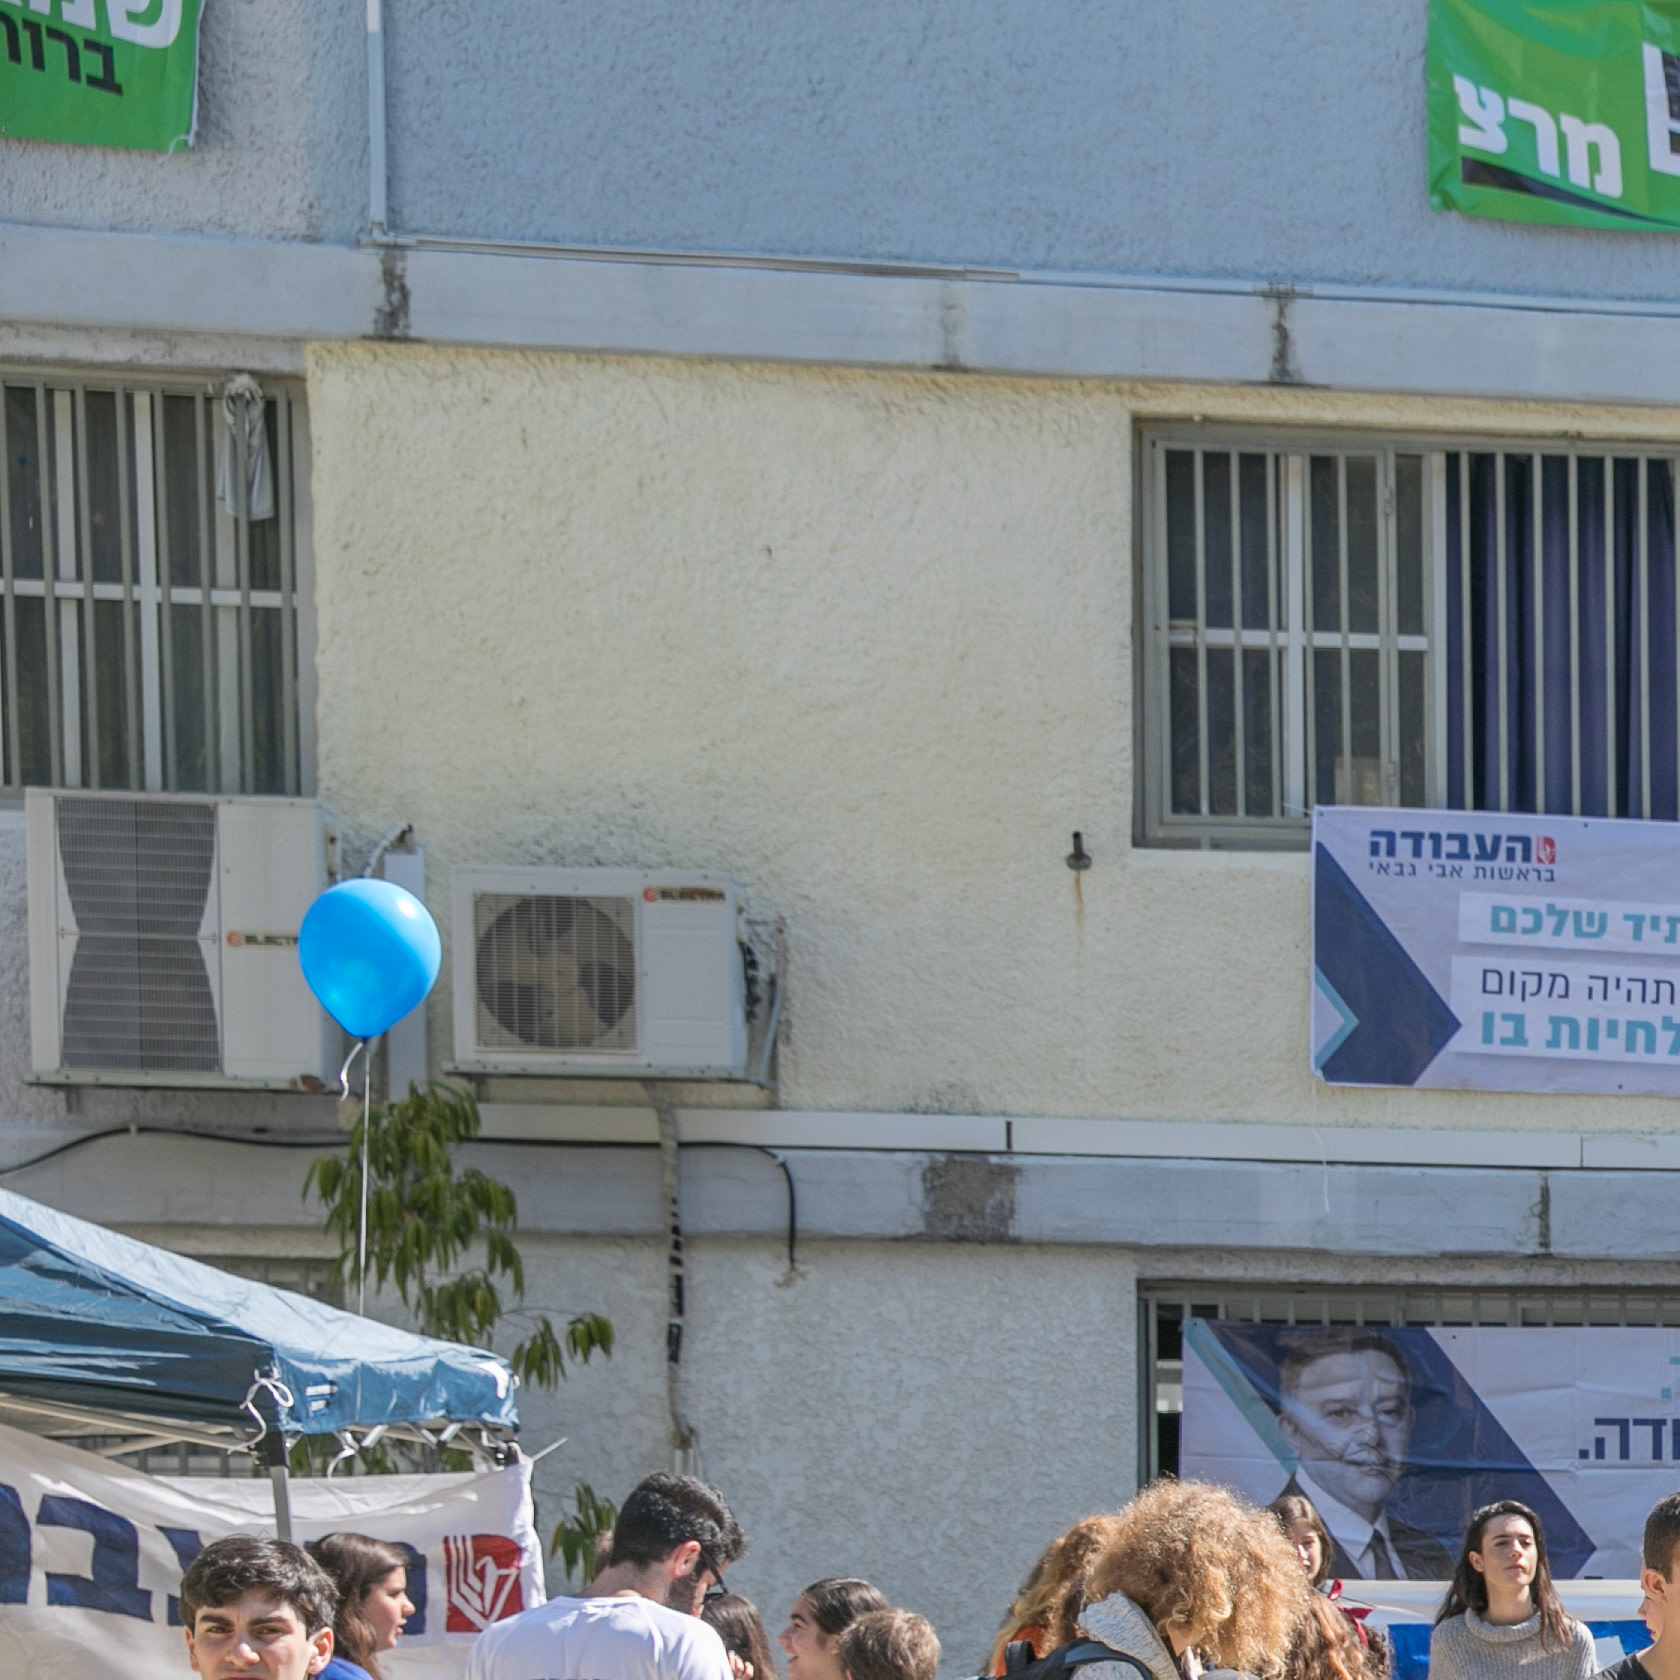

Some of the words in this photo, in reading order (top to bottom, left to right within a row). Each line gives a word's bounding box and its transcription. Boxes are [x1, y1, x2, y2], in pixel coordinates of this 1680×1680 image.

[1454, 74, 1623, 198] מרצ
[1369, 829, 1532, 863] העבודה
[1369, 862, 1417, 877] גבאי
[1429, 864, 1463, 879] אבי
[1473, 866, 1556, 882] בראשות
[1490, 903, 1608, 940] שלכם
[1482, 968, 1570, 1003] מקום
[1588, 973, 1676, 1006] תהיה
[1481, 1010, 1529, 1049] בו
